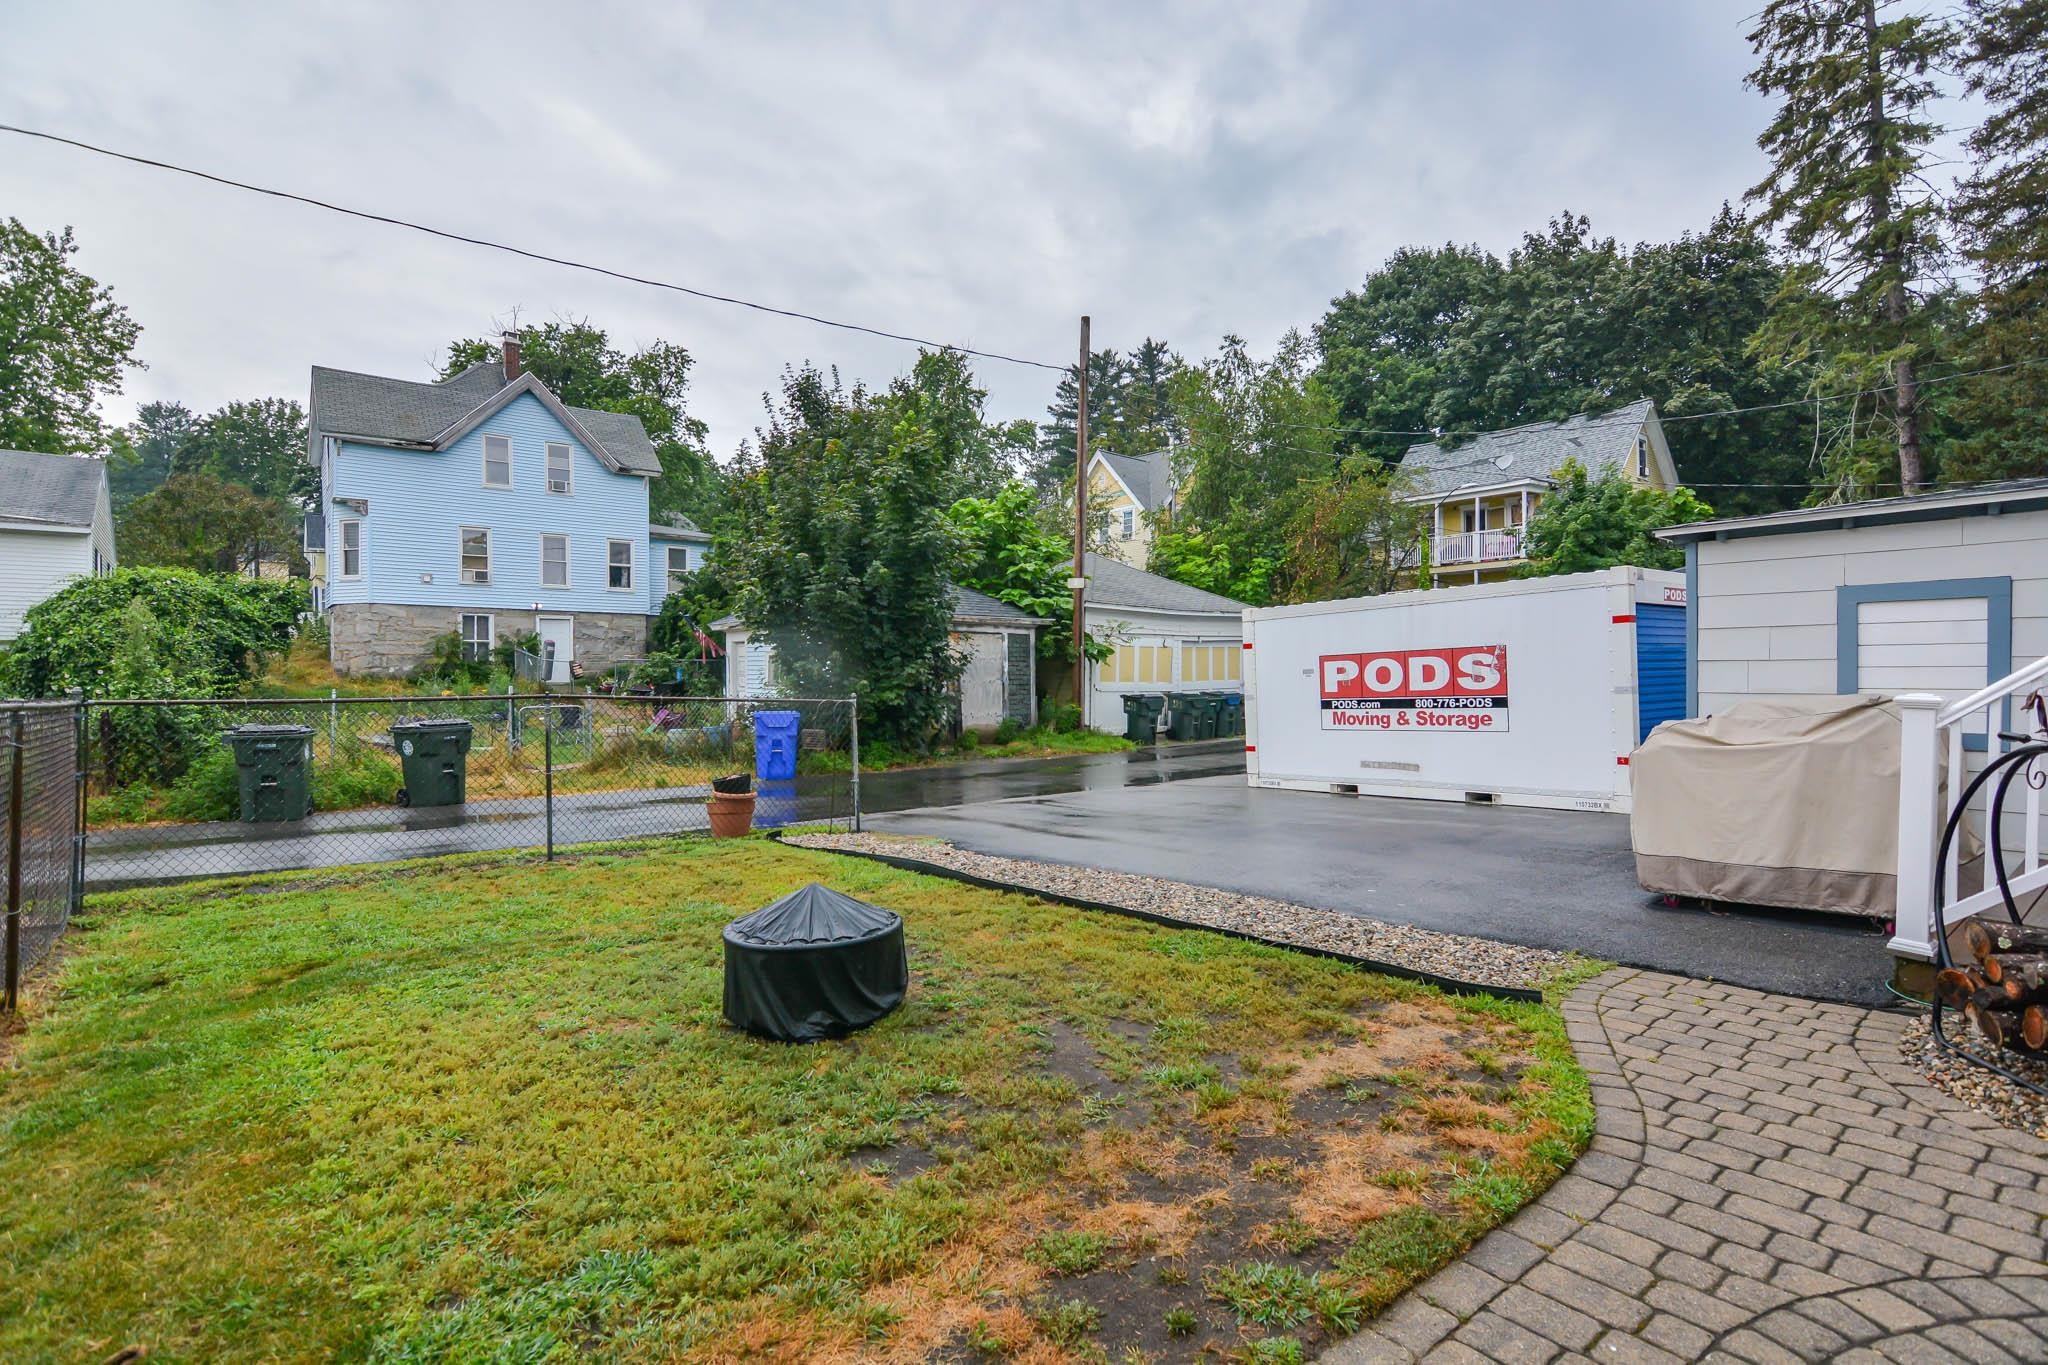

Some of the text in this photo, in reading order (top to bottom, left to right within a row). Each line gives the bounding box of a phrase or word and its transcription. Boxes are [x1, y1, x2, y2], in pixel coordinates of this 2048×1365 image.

[1664, 589, 1687, 601] PODS
[1323, 653, 1501, 693] PODS
[1332, 698, 1493, 709] PODS.com 800-776-PODS
[1332, 710, 1493, 730] Moving & Storage
